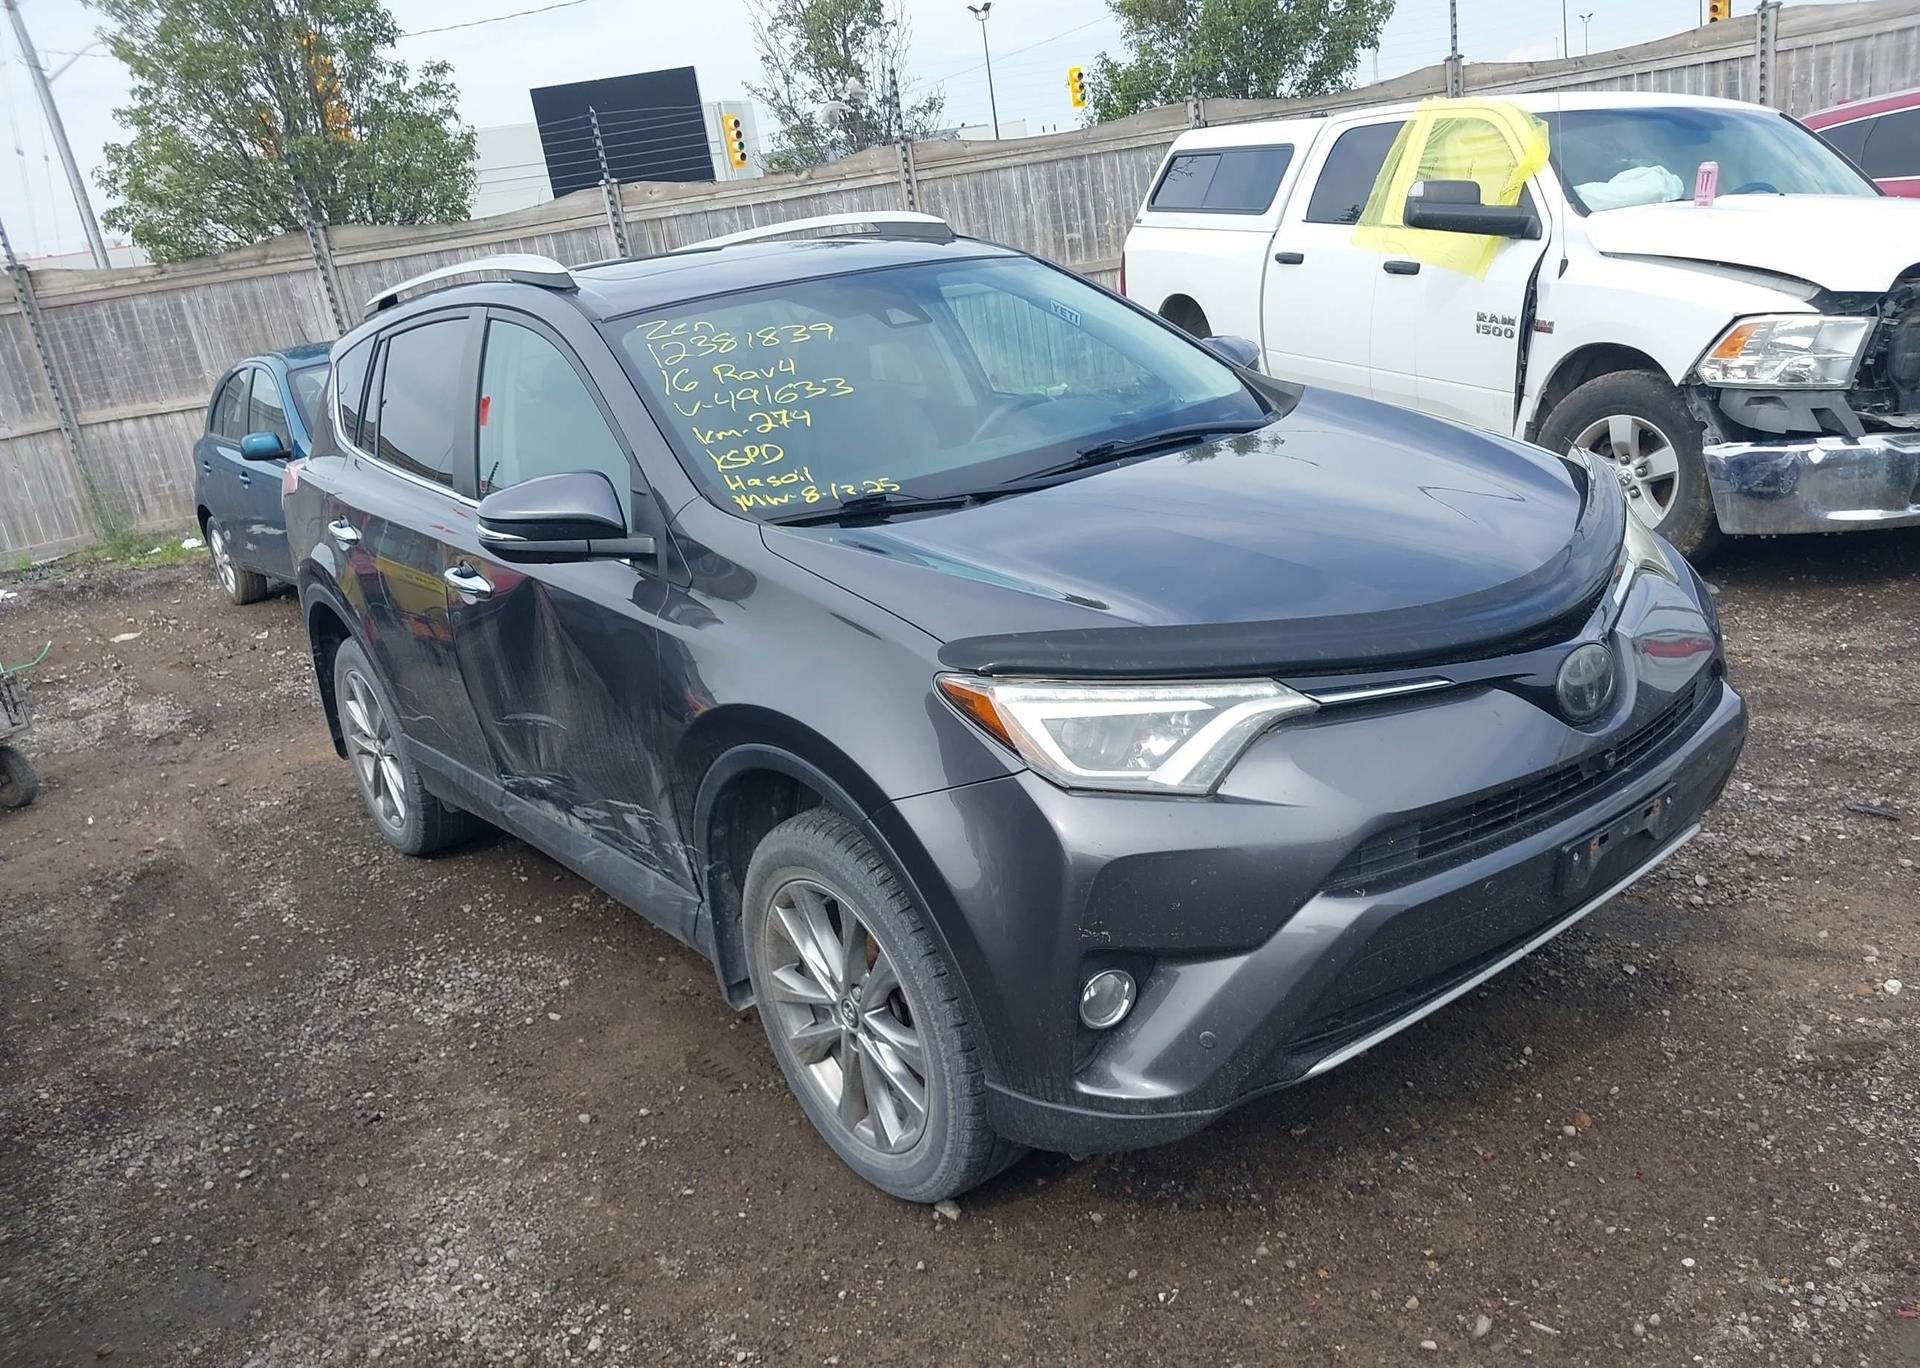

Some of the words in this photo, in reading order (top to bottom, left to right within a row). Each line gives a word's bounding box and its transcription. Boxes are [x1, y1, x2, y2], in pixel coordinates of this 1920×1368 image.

[1051, 302, 1079, 324] YETI
[1476, 311, 1517, 326] RAM
[1475, 323, 1515, 340] 1500
[646, 322, 834, 369] 12381839
[660, 368, 699, 396] 16
[713, 357, 796, 385] Rav4
